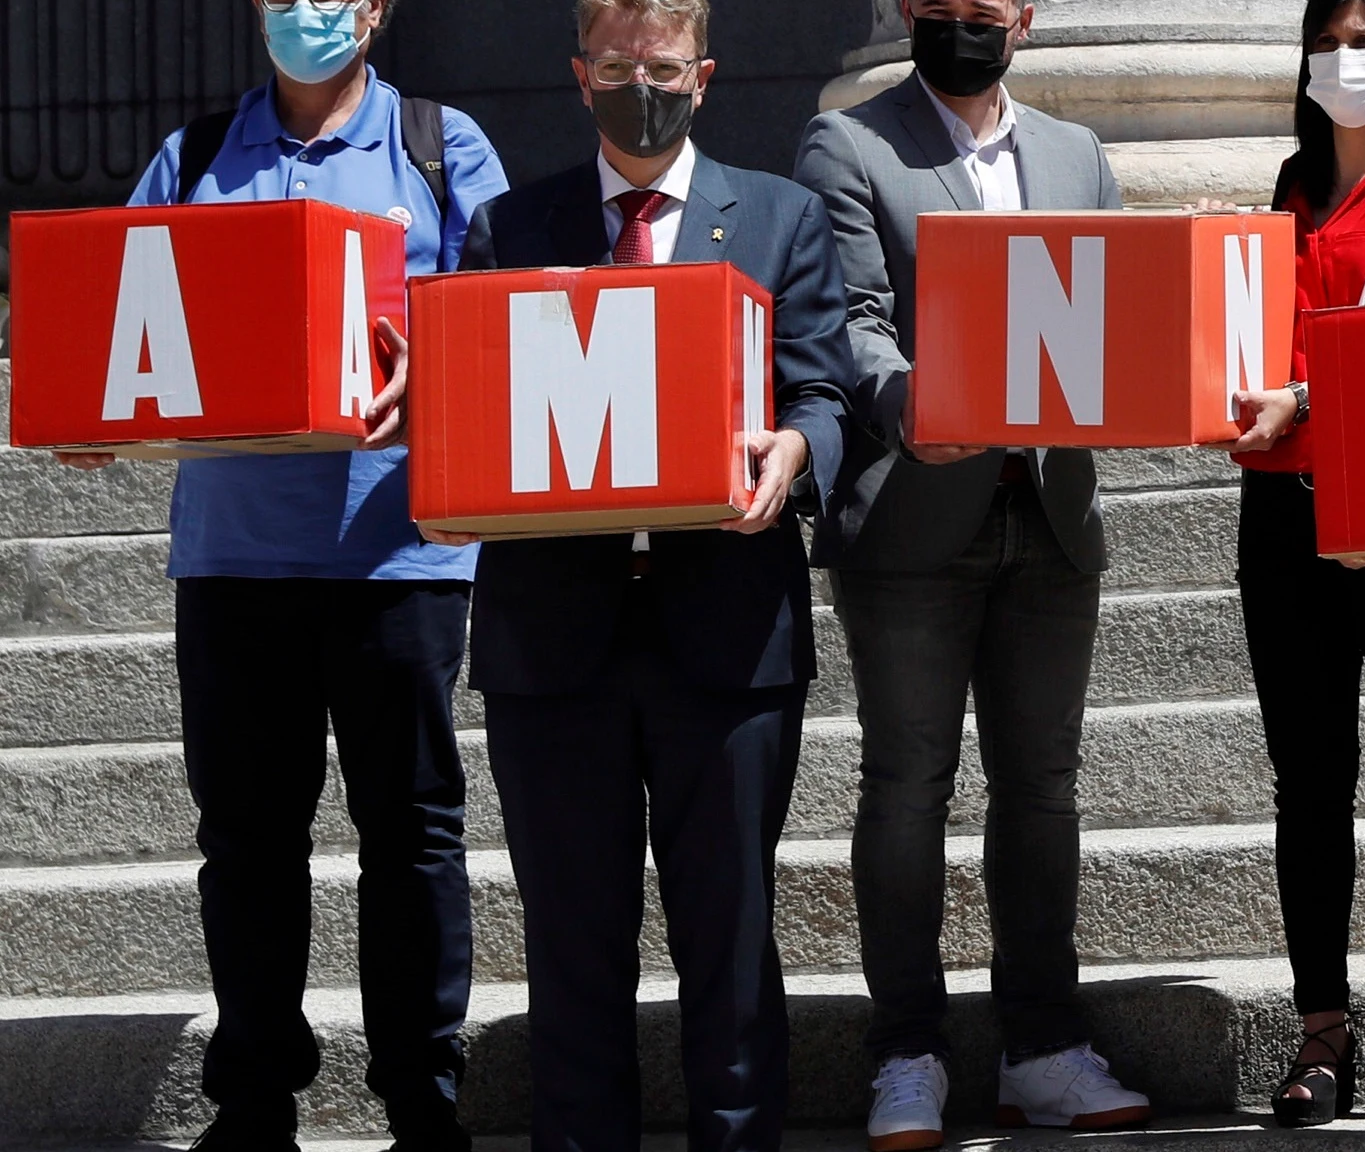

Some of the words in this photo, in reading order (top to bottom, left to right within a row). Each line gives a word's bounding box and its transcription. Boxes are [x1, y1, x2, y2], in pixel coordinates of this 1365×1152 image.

[101, 225, 204, 421] A
[339, 228, 374, 420] A
[508, 286, 659, 493] M
[743, 293, 766, 492] M
[1006, 235, 1105, 426] N
[1223, 233, 1265, 423] N
